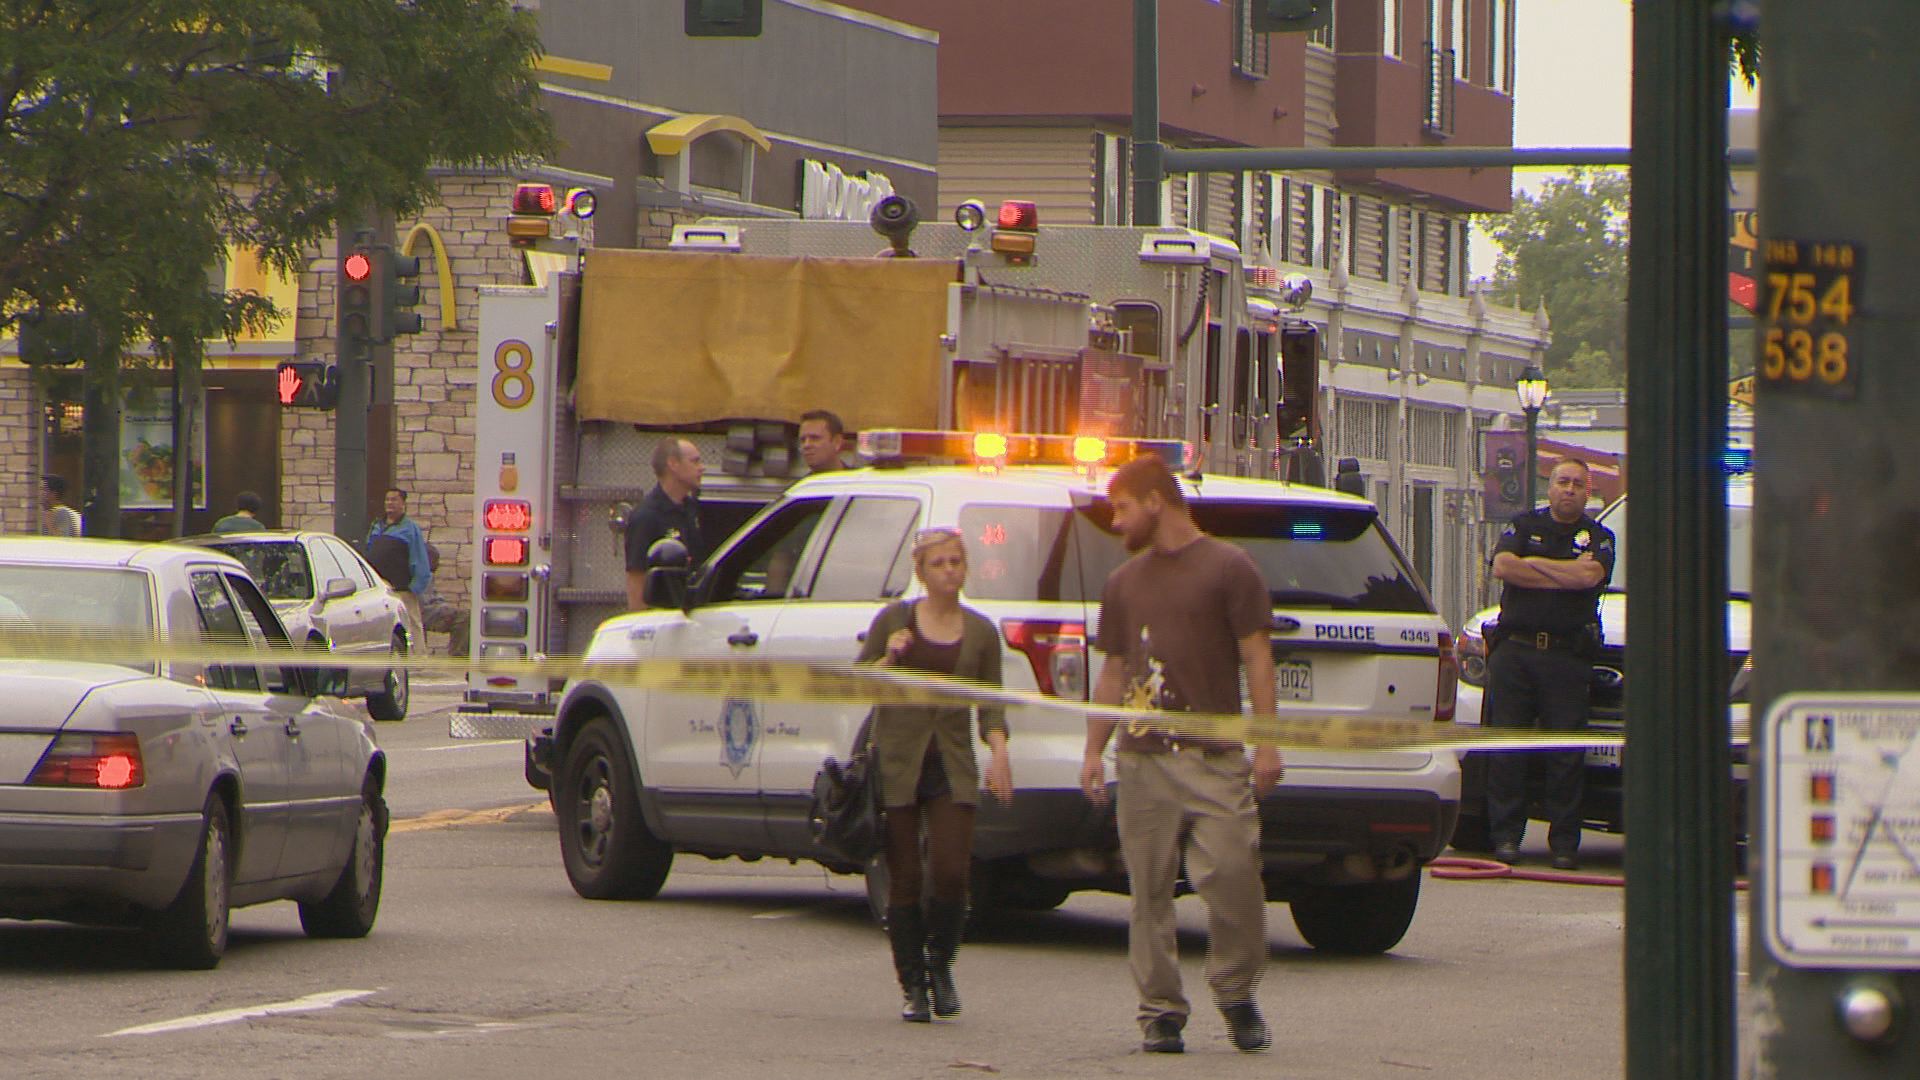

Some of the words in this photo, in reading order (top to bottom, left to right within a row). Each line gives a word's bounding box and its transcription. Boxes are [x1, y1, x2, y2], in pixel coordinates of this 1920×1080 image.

[1767, 272, 1852, 326] 754
[491, 339, 534, 409] 8
[1764, 327, 1848, 384] 538
[1315, 623, 1376, 641] POLICE
[1400, 628, 1430, 643] 4345
